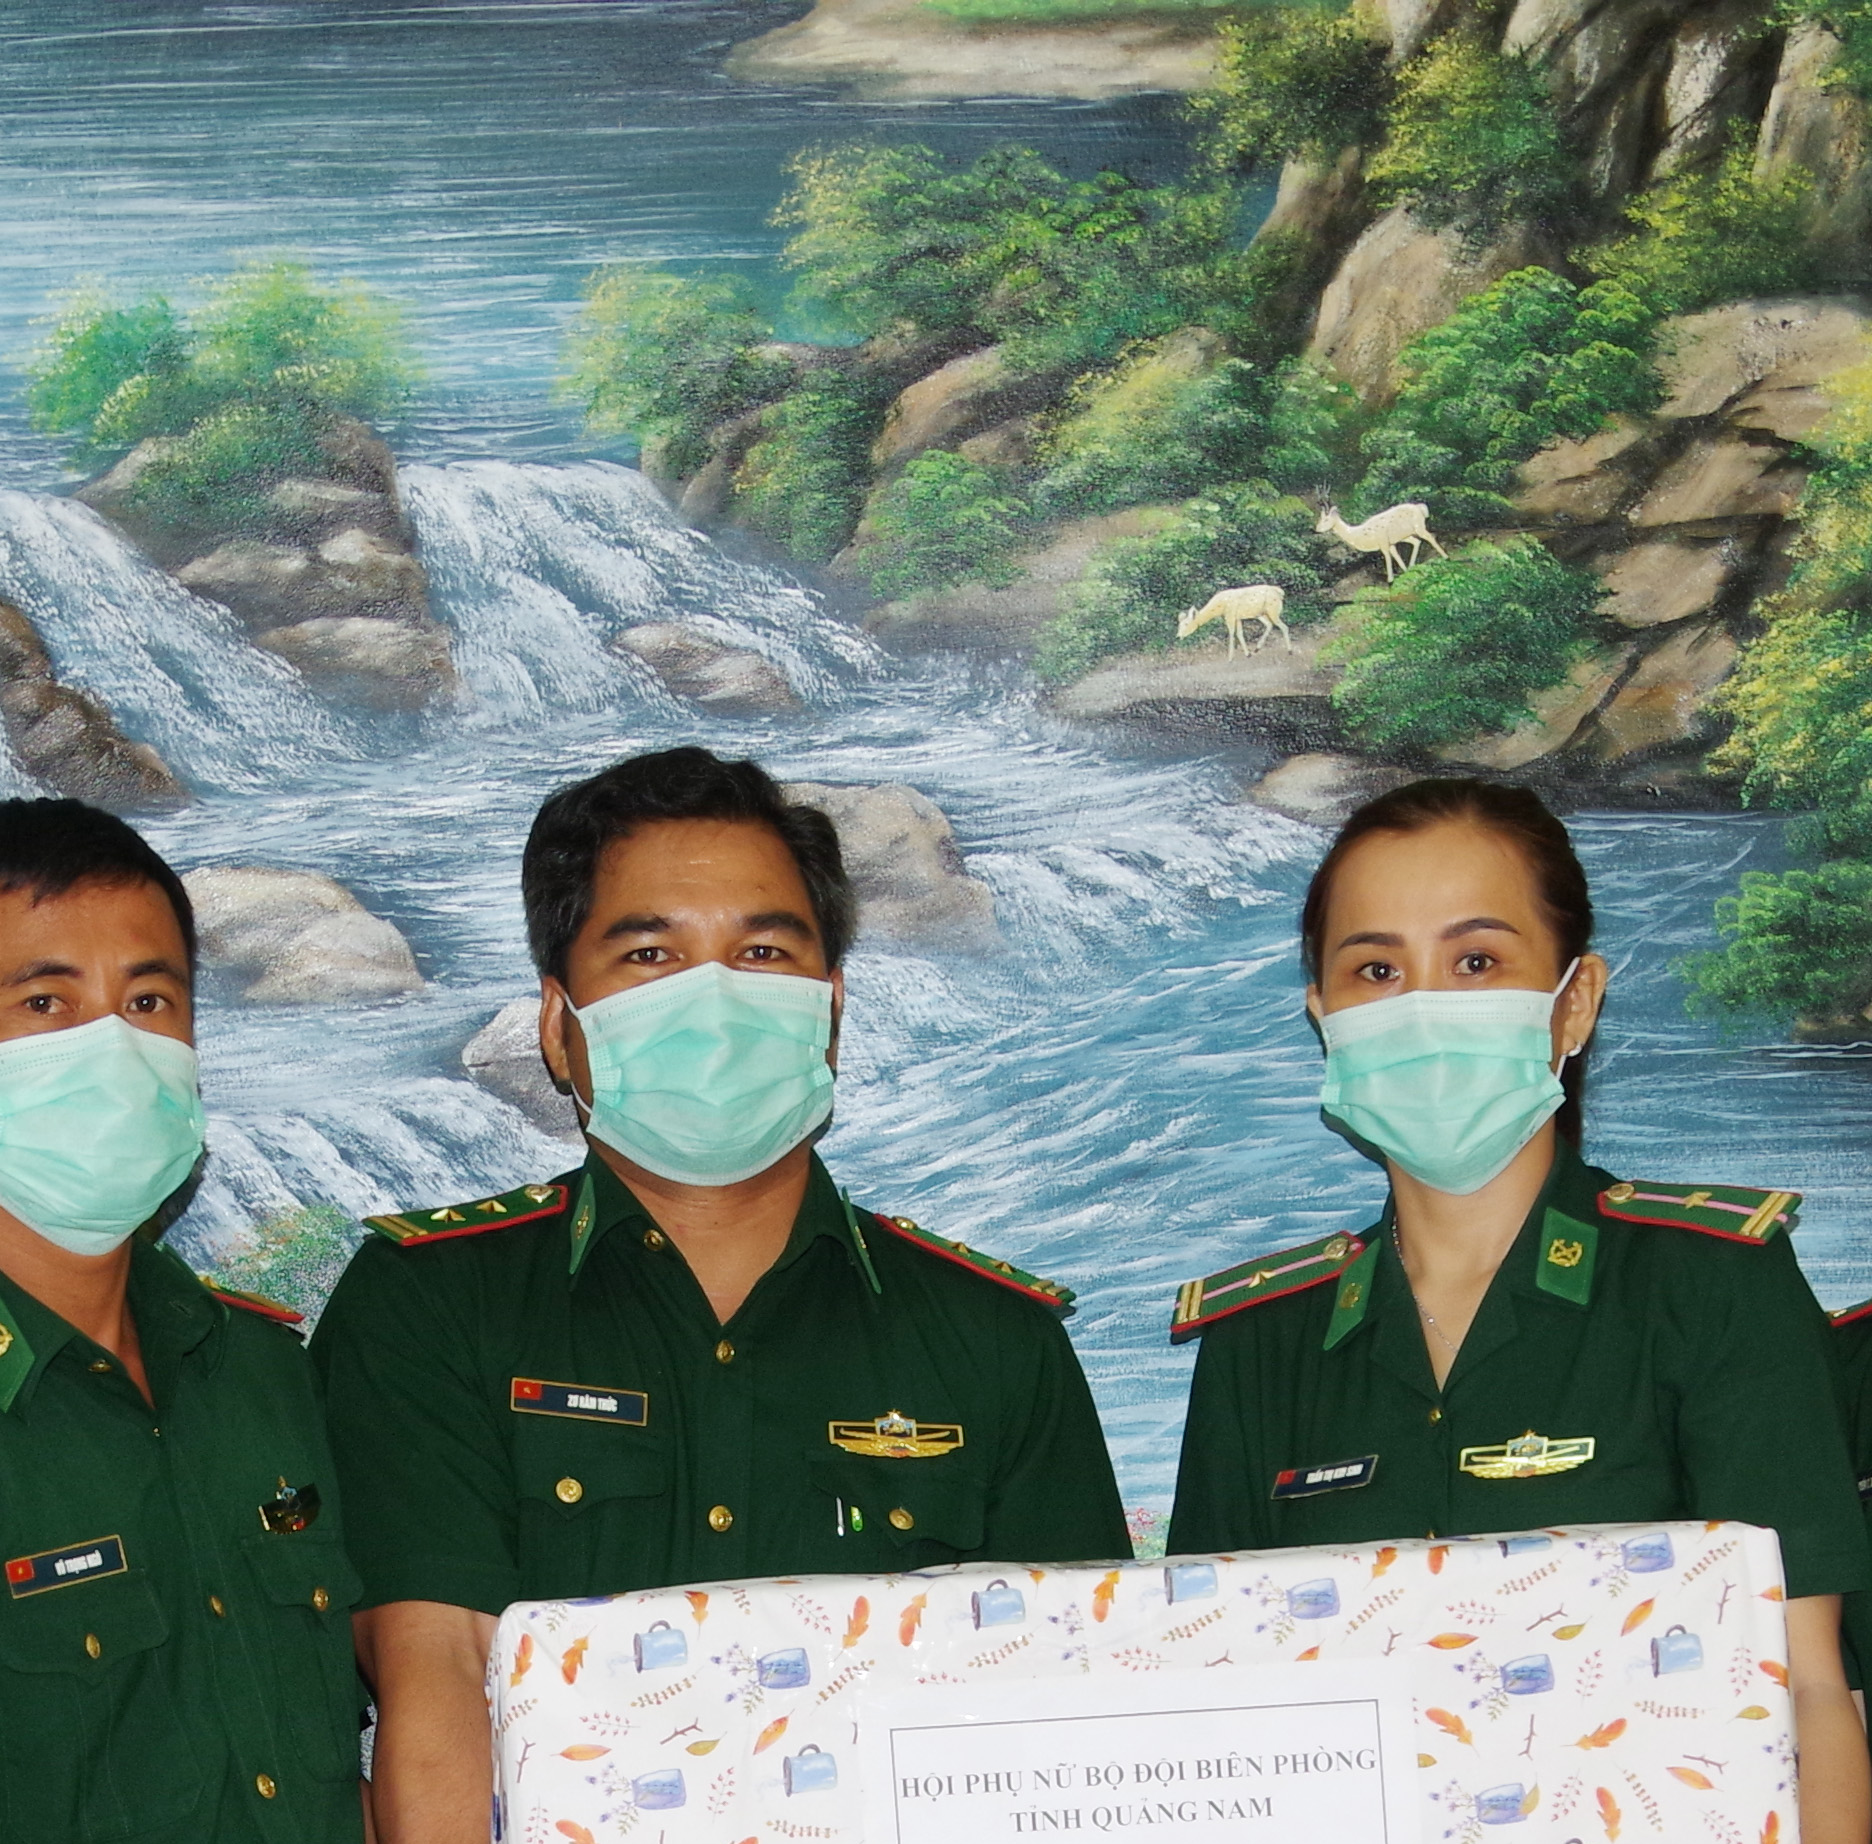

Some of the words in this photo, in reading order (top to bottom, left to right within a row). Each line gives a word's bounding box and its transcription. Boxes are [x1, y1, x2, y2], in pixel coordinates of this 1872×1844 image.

[901, 1773, 954, 1802] HỘI
[965, 1771, 1022, 1797] PHỤ
[1033, 1763, 1076, 1790] NỮ
[1085, 1761, 1124, 1790] BỘ
[1134, 1758, 1186, 1787] ĐỘI
[1195, 1751, 1262, 1779] BIÊN
[1274, 1746, 1376, 1775] PHÒNG
[1009, 1805, 1081, 1832] TỈNH
[1092, 1798, 1197, 1832] QUẢNG
[1207, 1797, 1273, 1820] NAM
